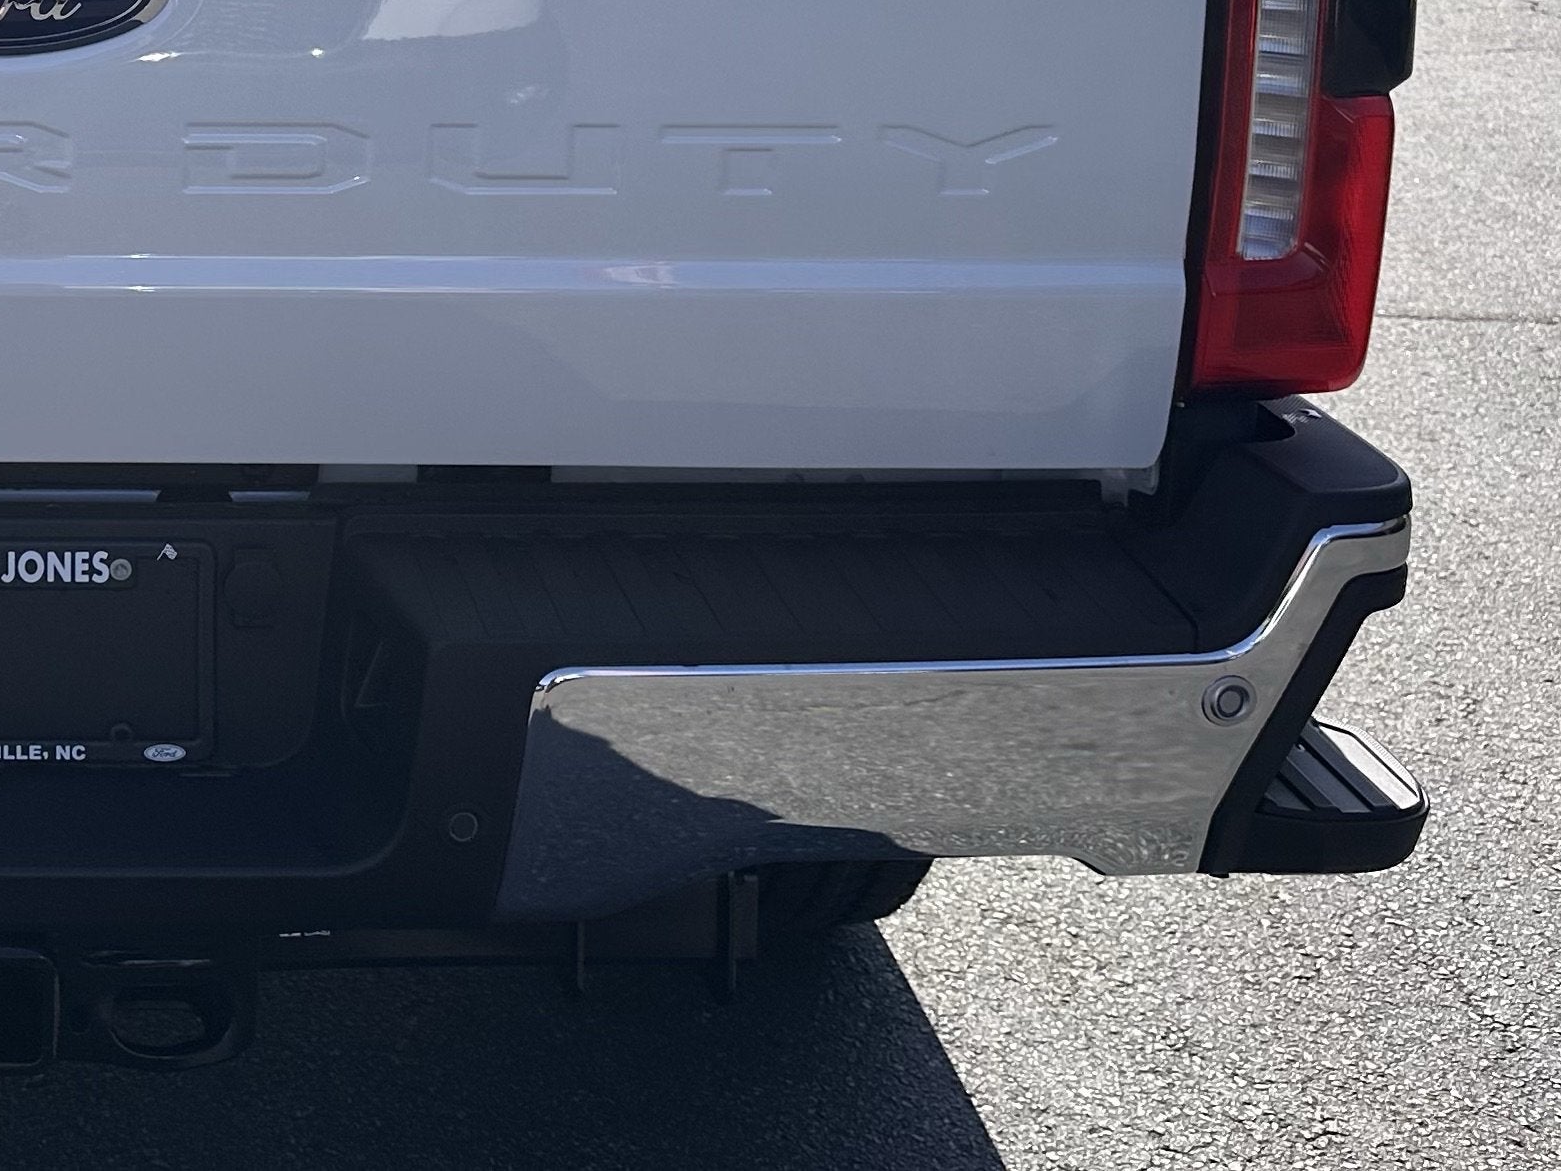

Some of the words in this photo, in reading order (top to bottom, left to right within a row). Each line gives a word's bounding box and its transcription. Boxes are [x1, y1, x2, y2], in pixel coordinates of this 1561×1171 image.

[181, 121, 1060, 197] DUTY
[1, 550, 111, 585] JONES
[55, 744, 86, 762] NC
